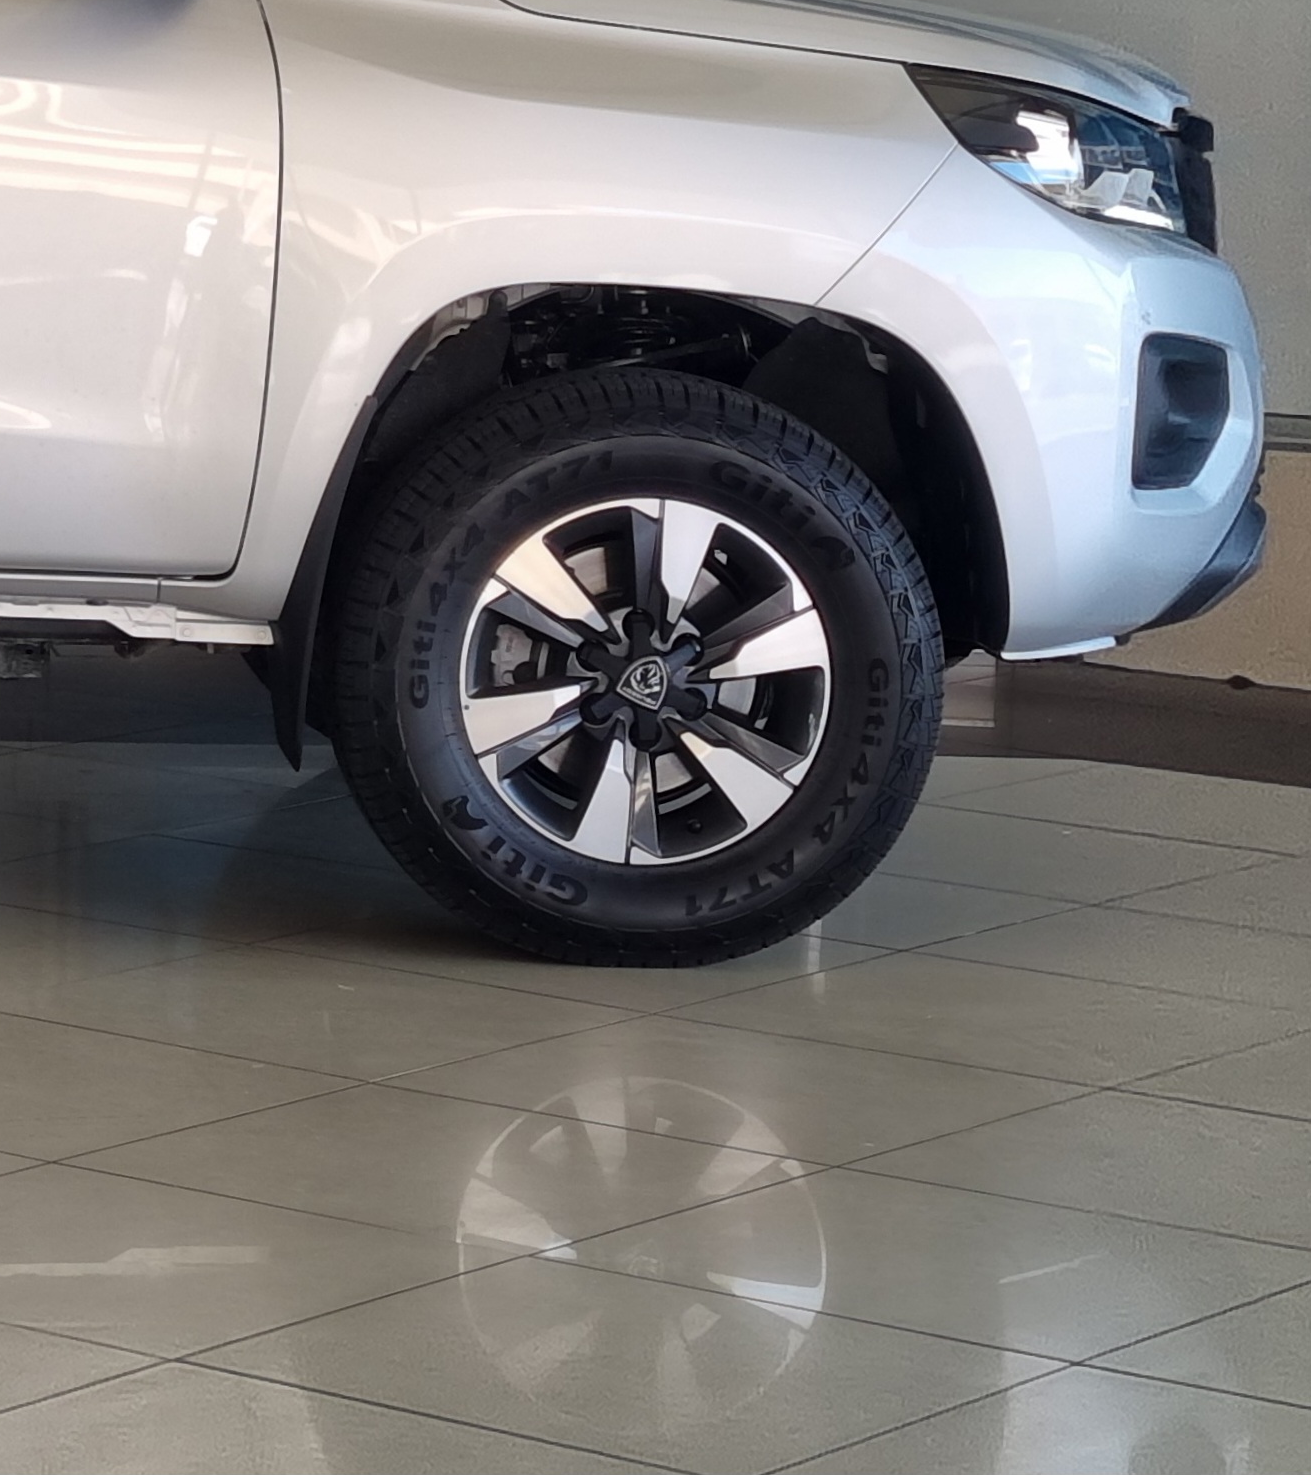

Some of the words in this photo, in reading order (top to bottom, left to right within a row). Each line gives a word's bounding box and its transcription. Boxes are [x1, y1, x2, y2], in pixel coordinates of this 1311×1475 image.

[499, 449, 614, 519] AT71
[708, 459, 815, 531] Giti
[479, 832, 590, 907] Giti
[683, 847, 797, 917] AT71
